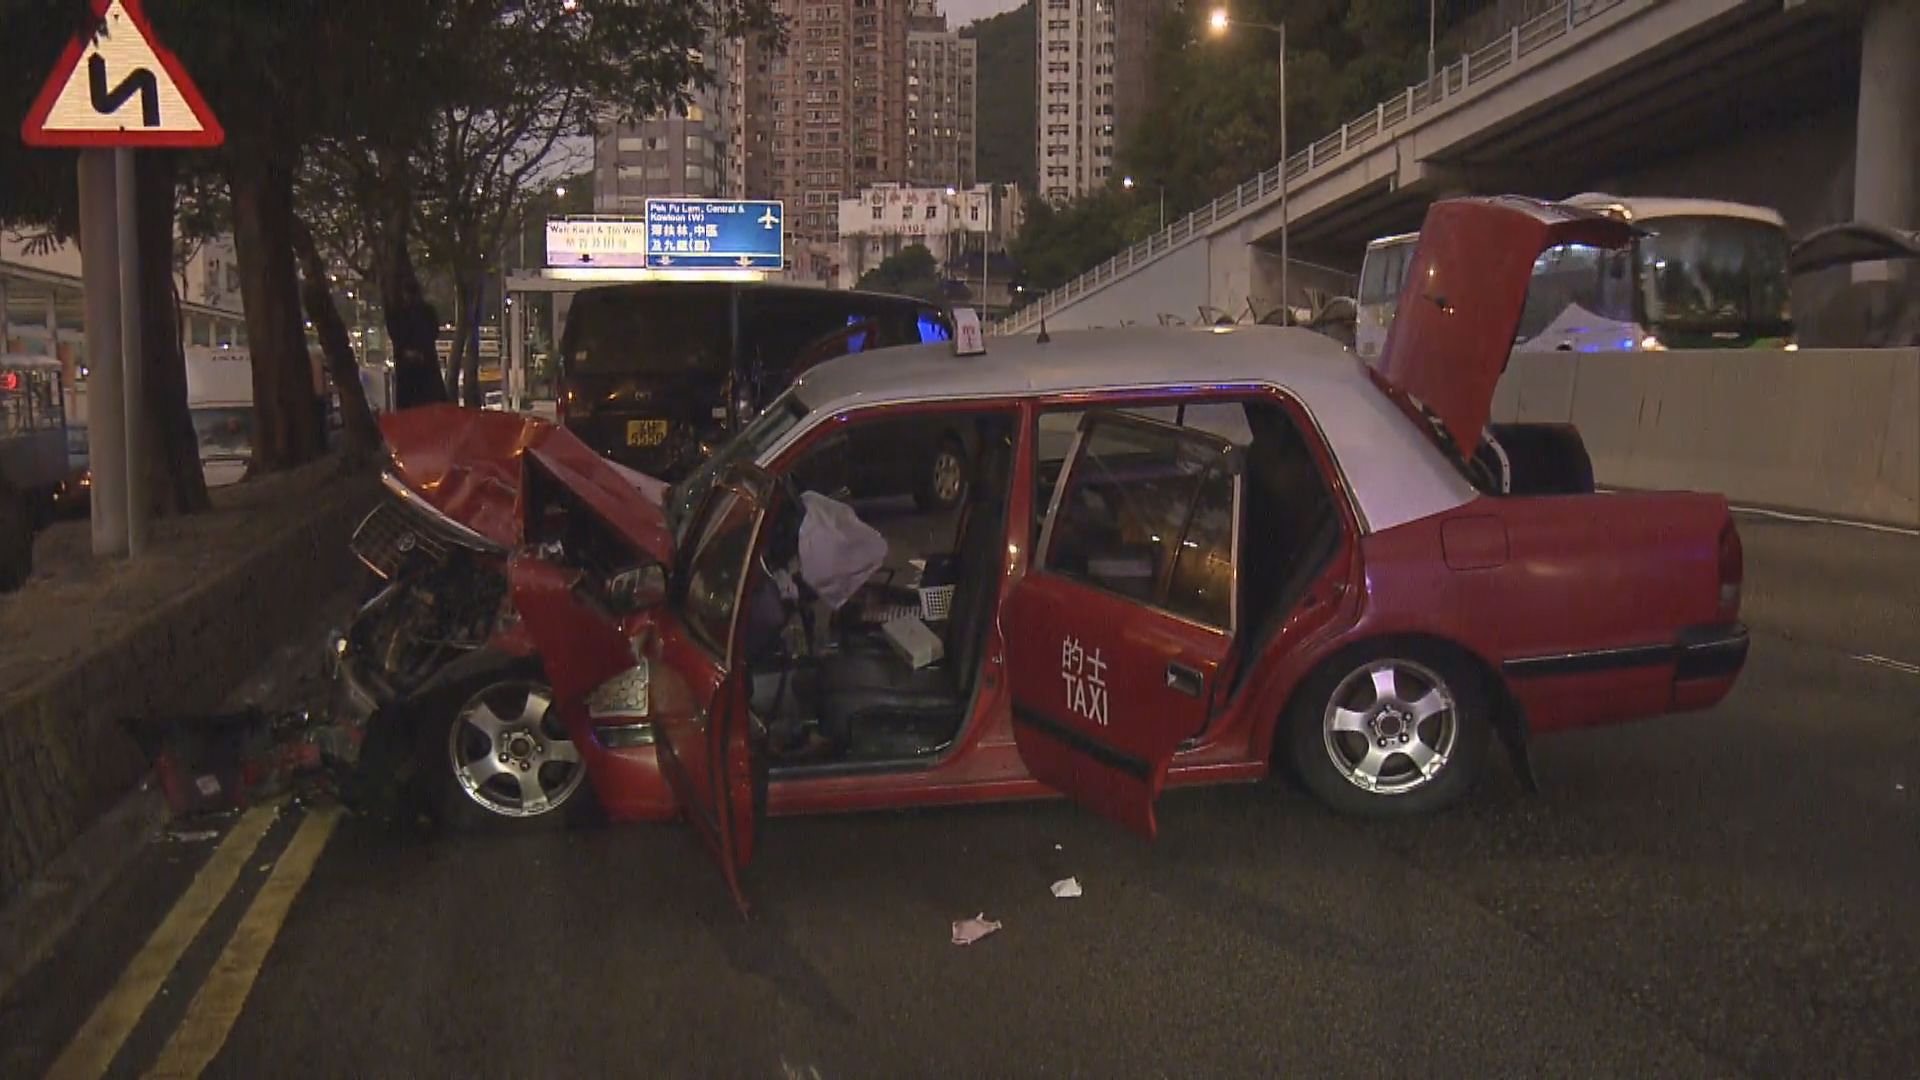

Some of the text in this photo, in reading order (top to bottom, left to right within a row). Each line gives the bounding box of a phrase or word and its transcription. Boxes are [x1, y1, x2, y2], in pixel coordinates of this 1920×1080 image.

[650, 203, 666, 213] Pok
[669, 204, 680, 213] Fu
[706, 204, 736, 213] Central
[650, 213, 705, 223] Kowloon (W)
[1062, 634, 1107, 687] 的士
[1062, 671, 1108, 726] TAXI
